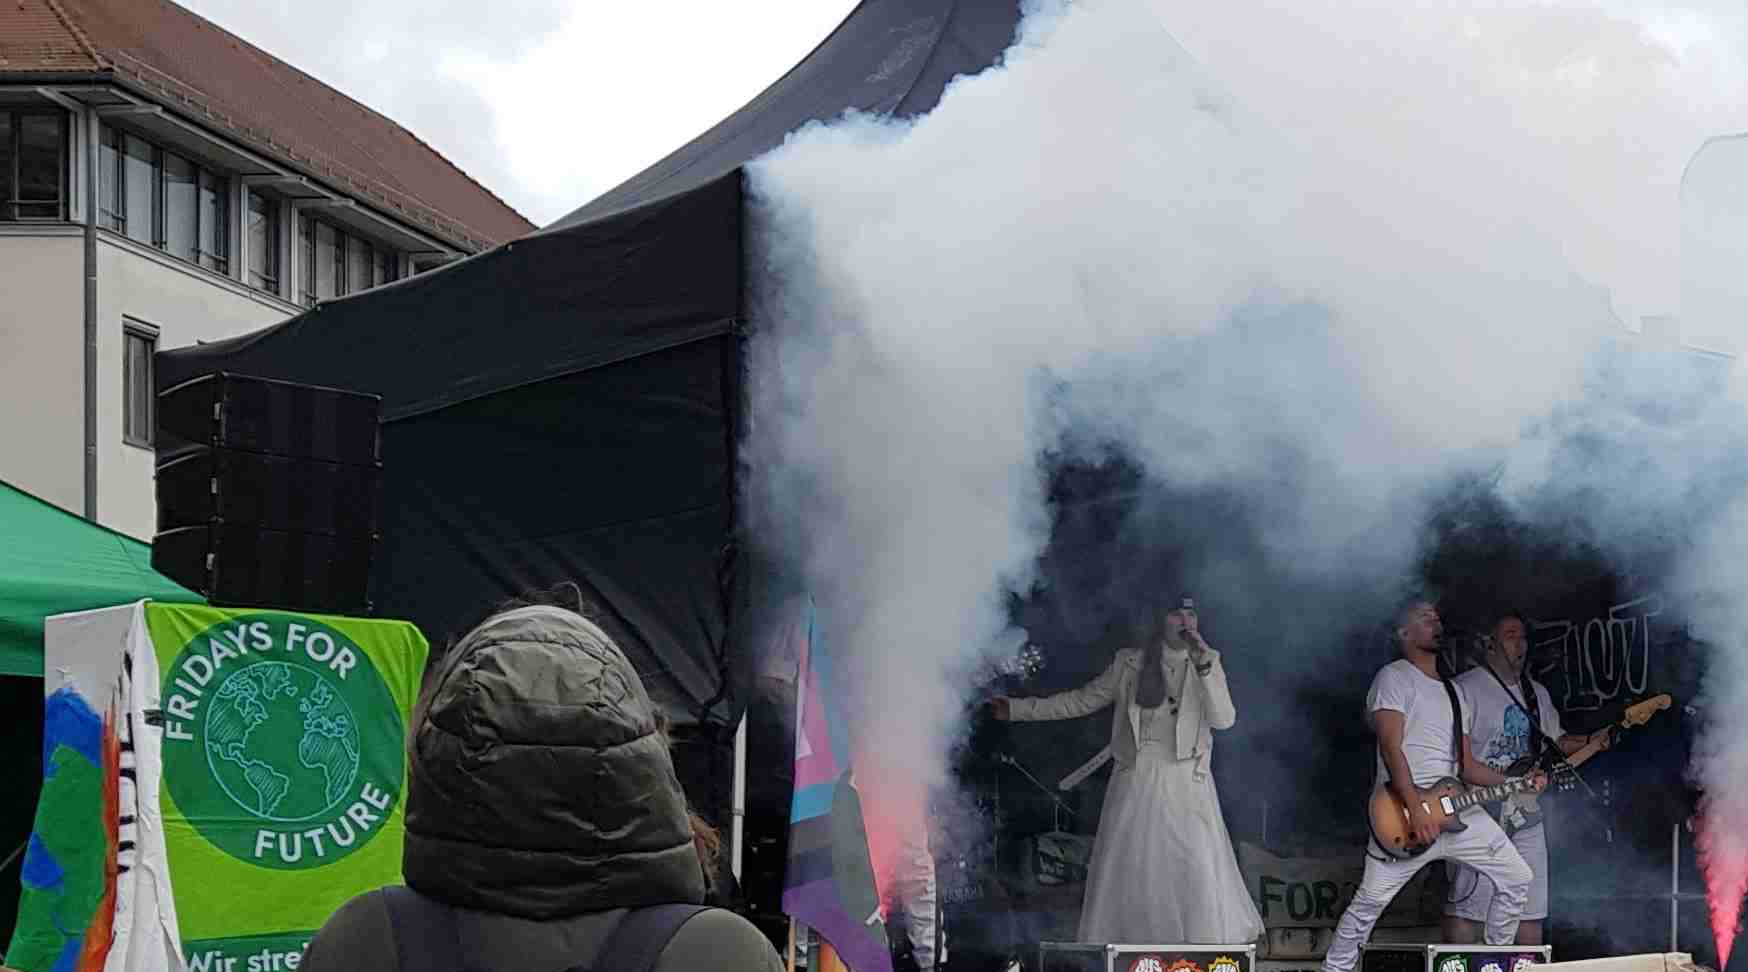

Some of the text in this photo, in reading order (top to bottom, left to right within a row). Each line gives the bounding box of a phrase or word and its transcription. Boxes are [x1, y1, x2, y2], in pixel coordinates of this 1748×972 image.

[164, 622, 357, 740] FRIDAYS FOR
[254, 782, 391, 862] FUTURE
